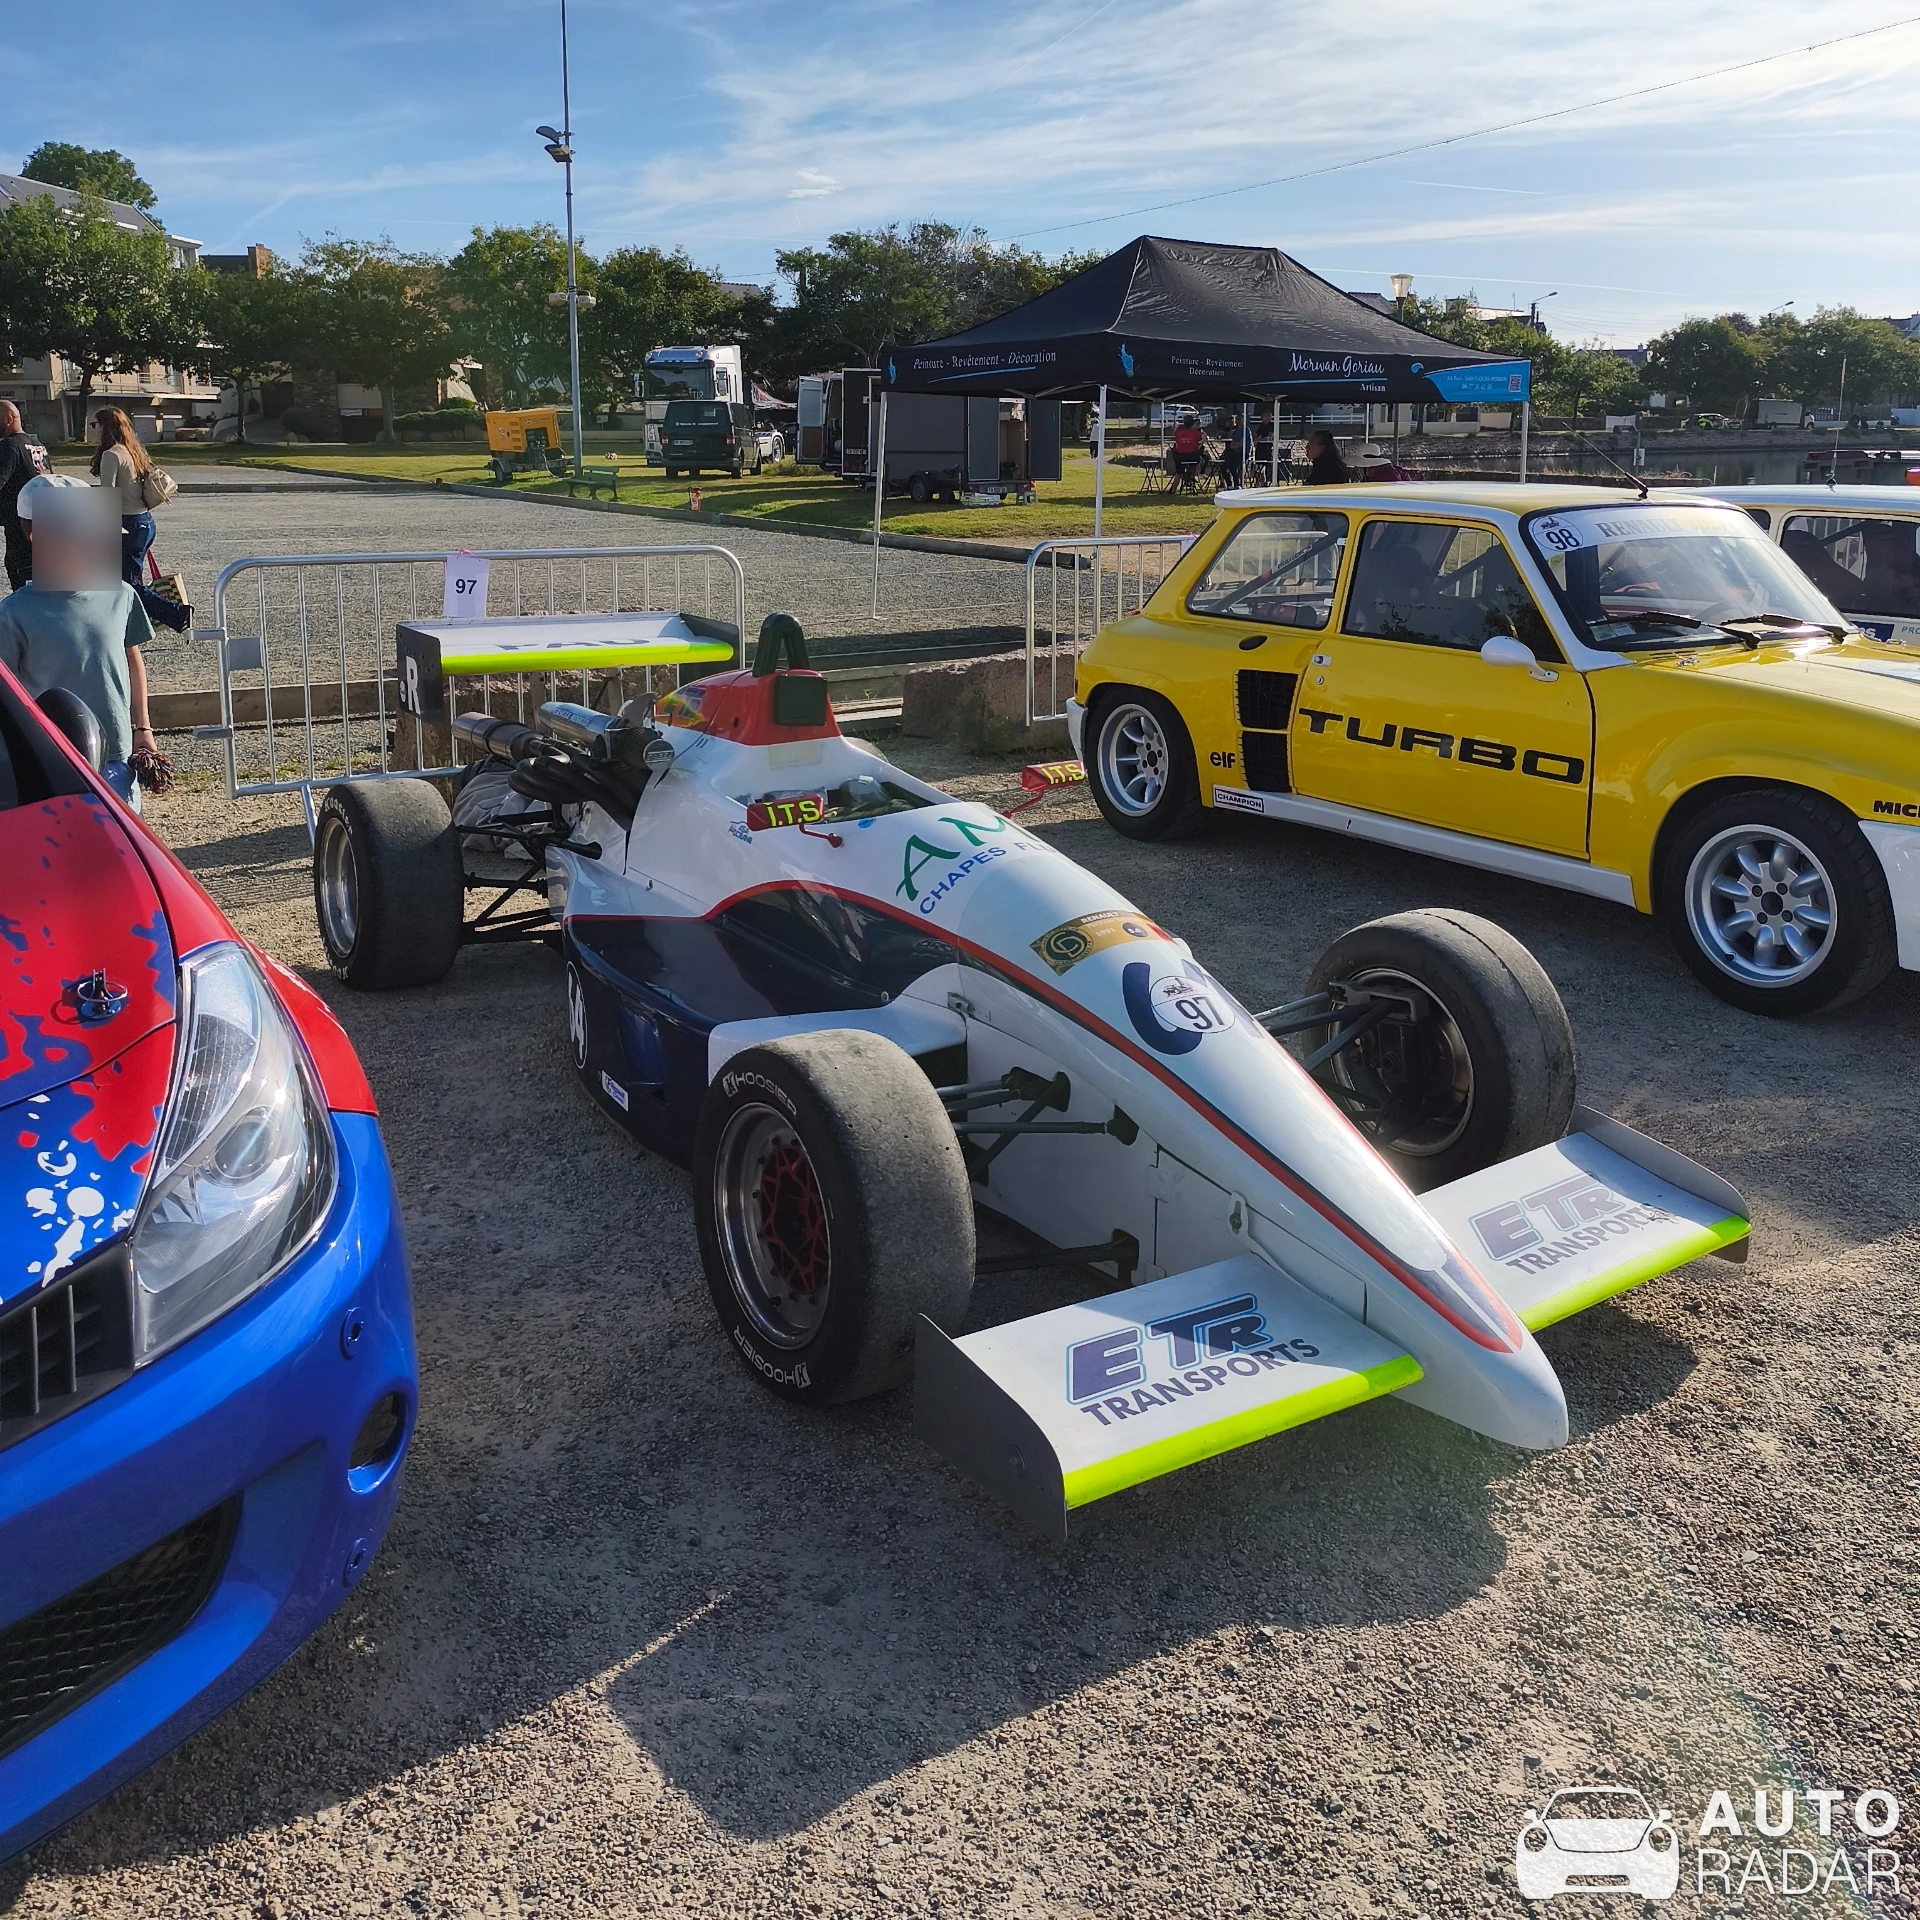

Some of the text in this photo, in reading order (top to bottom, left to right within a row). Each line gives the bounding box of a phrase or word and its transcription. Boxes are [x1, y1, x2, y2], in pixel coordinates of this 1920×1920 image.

[913, 349, 1056, 370] Peinture Revêtement Décoration
[1171, 355, 1244, 368] Peinture Revêtement
[1189, 366, 1225, 377] Décoration
[693, 391, 704, 399] TIR
[1360, 382, 1386, 392] Artisan
[1595, 518, 1684, 538] RENAULT
[1545, 528, 1581, 551] 98
[455, 578, 478, 595] 97
[1298, 707, 1586, 785] TURBO
[1209, 751, 1236, 769] elf
[1217, 793, 1262, 808] CHAMPION
[1873, 800, 1920, 818] MIC
[919, 846, 1007, 915] CHAPES
[1080, 911, 1120, 924] RENAULT
[1174, 996, 1225, 1030] 97
[735, 1071, 797, 1119] HOOSIER
[1466, 1170, 1625, 1262] ETR
[733, 1325, 797, 1385] HOOSIER
[1066, 1292, 1275, 1406] ETR
[1080, 1338, 1320, 1426] TRANSPORTS
